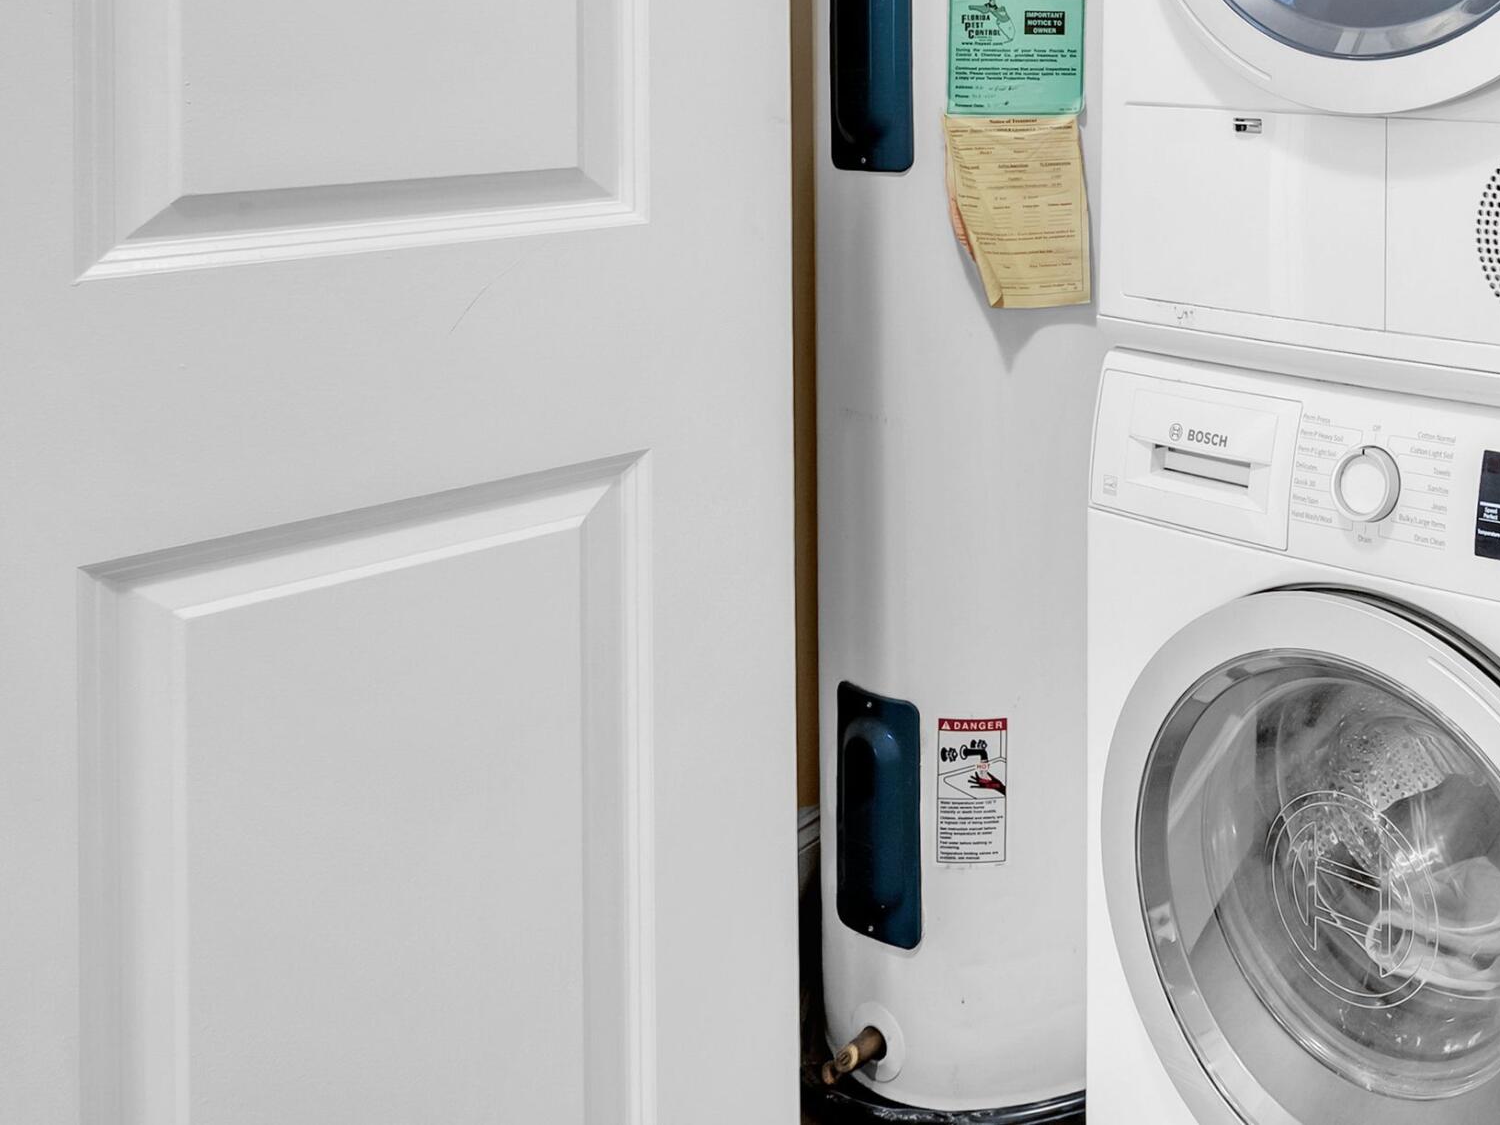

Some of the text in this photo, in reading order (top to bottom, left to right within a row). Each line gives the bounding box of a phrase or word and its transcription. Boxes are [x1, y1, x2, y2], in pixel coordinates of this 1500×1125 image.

[962, 15, 990, 24] FLORIDA
[965, 22, 983, 31] PEST
[968, 30, 1000, 39] CONTROL
[1187, 429, 1228, 447] BOSCH
[954, 721, 1002, 730] DANGER
